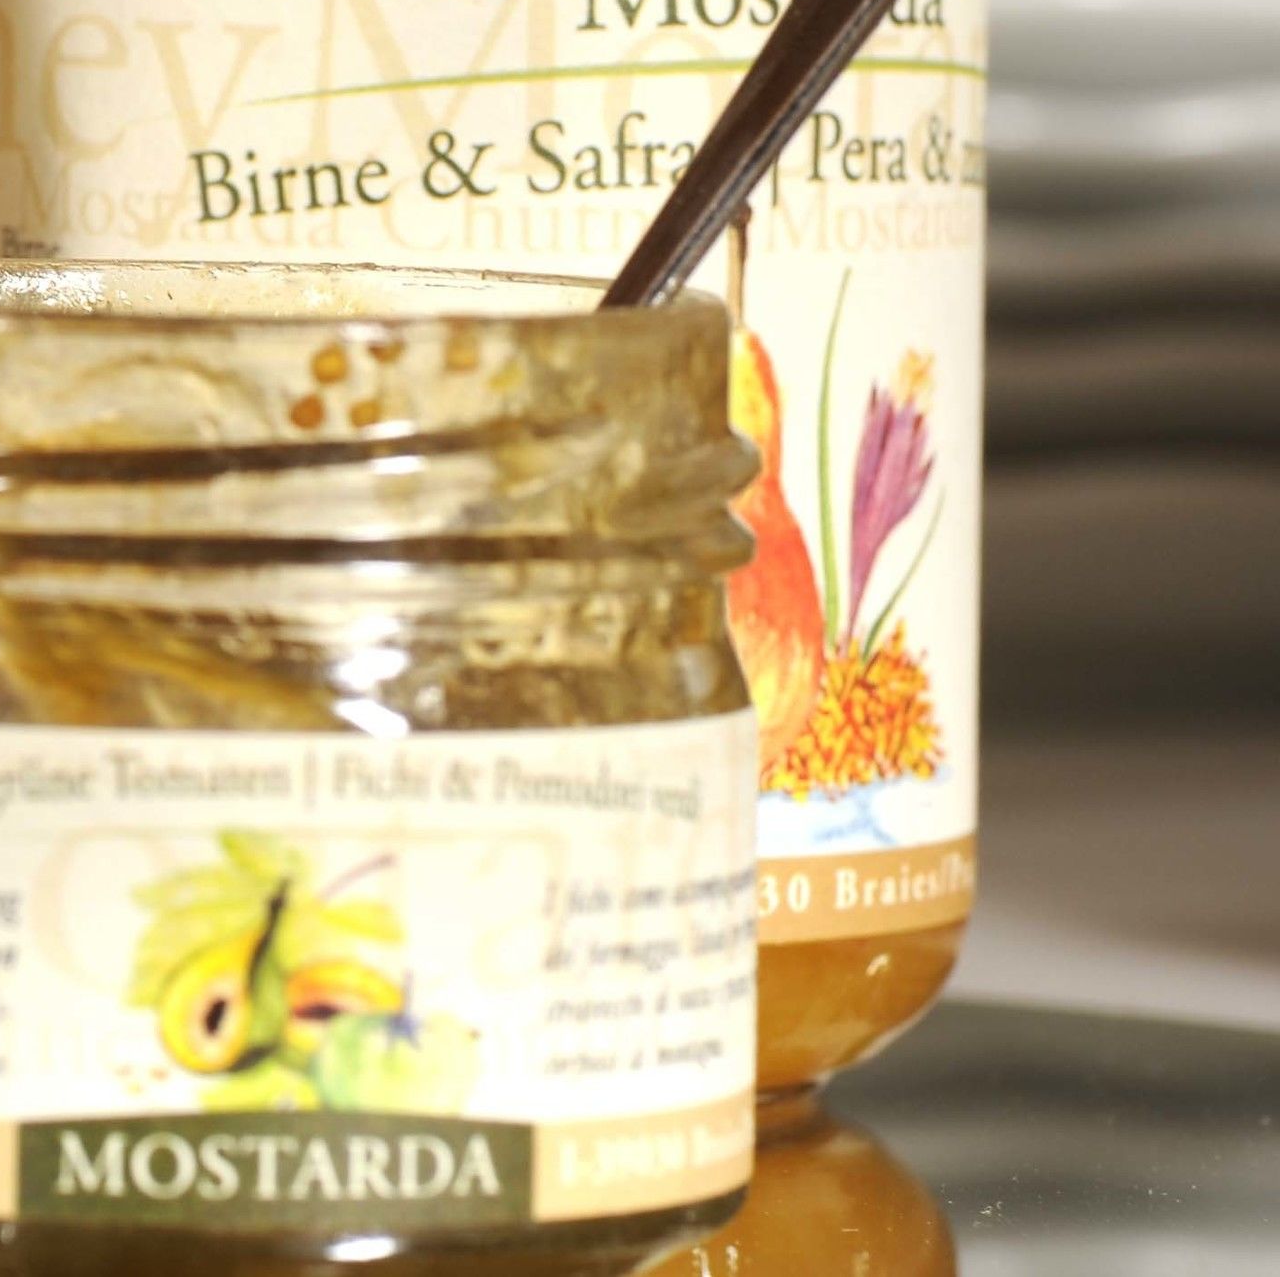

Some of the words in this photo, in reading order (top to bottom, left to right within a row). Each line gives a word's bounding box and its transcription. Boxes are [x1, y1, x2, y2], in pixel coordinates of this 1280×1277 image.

[192, 149, 391, 224] Birne
[422, 130, 497, 202] &
[526, 110, 704, 195] Safra
[807, 111, 908, 185] Pera
[922, 113, 953, 184] &
[55, 1128, 502, 1202] MOSTARDA
